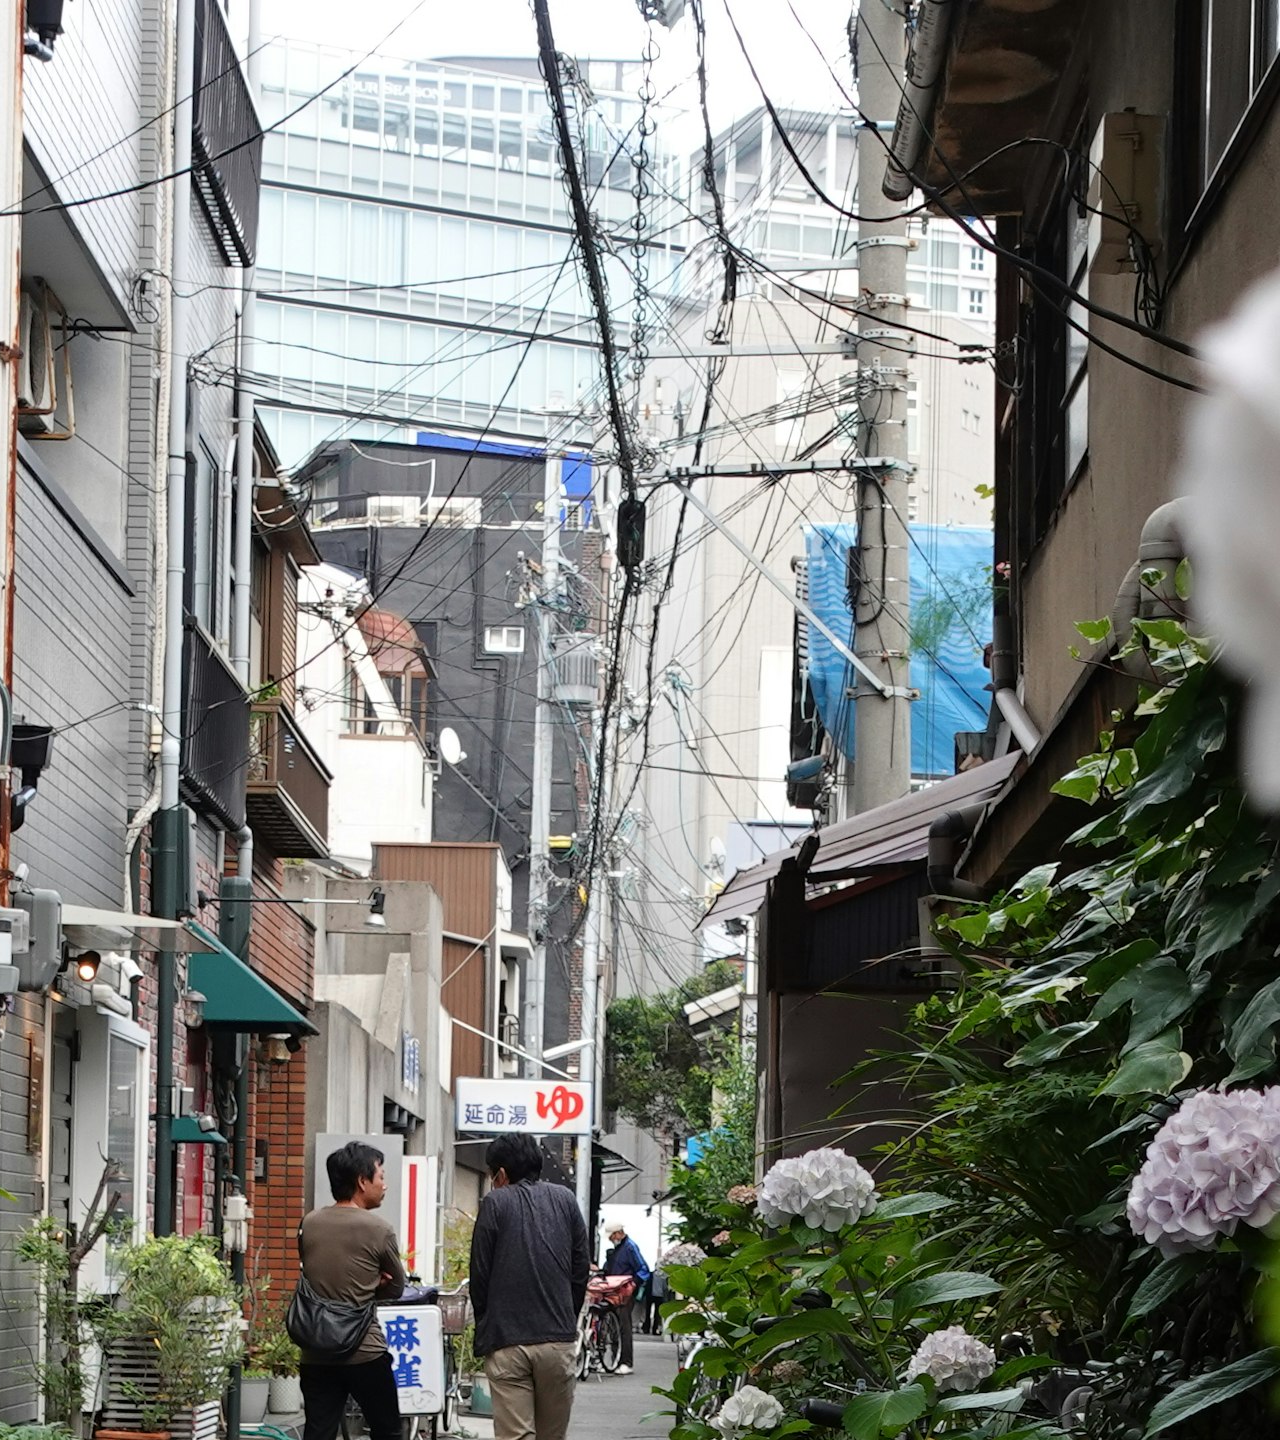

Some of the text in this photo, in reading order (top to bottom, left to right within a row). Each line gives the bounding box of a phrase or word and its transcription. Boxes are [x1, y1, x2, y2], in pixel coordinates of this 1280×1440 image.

[465, 1085, 584, 1130] 延命湯 ゆ
[384, 1315, 423, 1388] 麻雀
